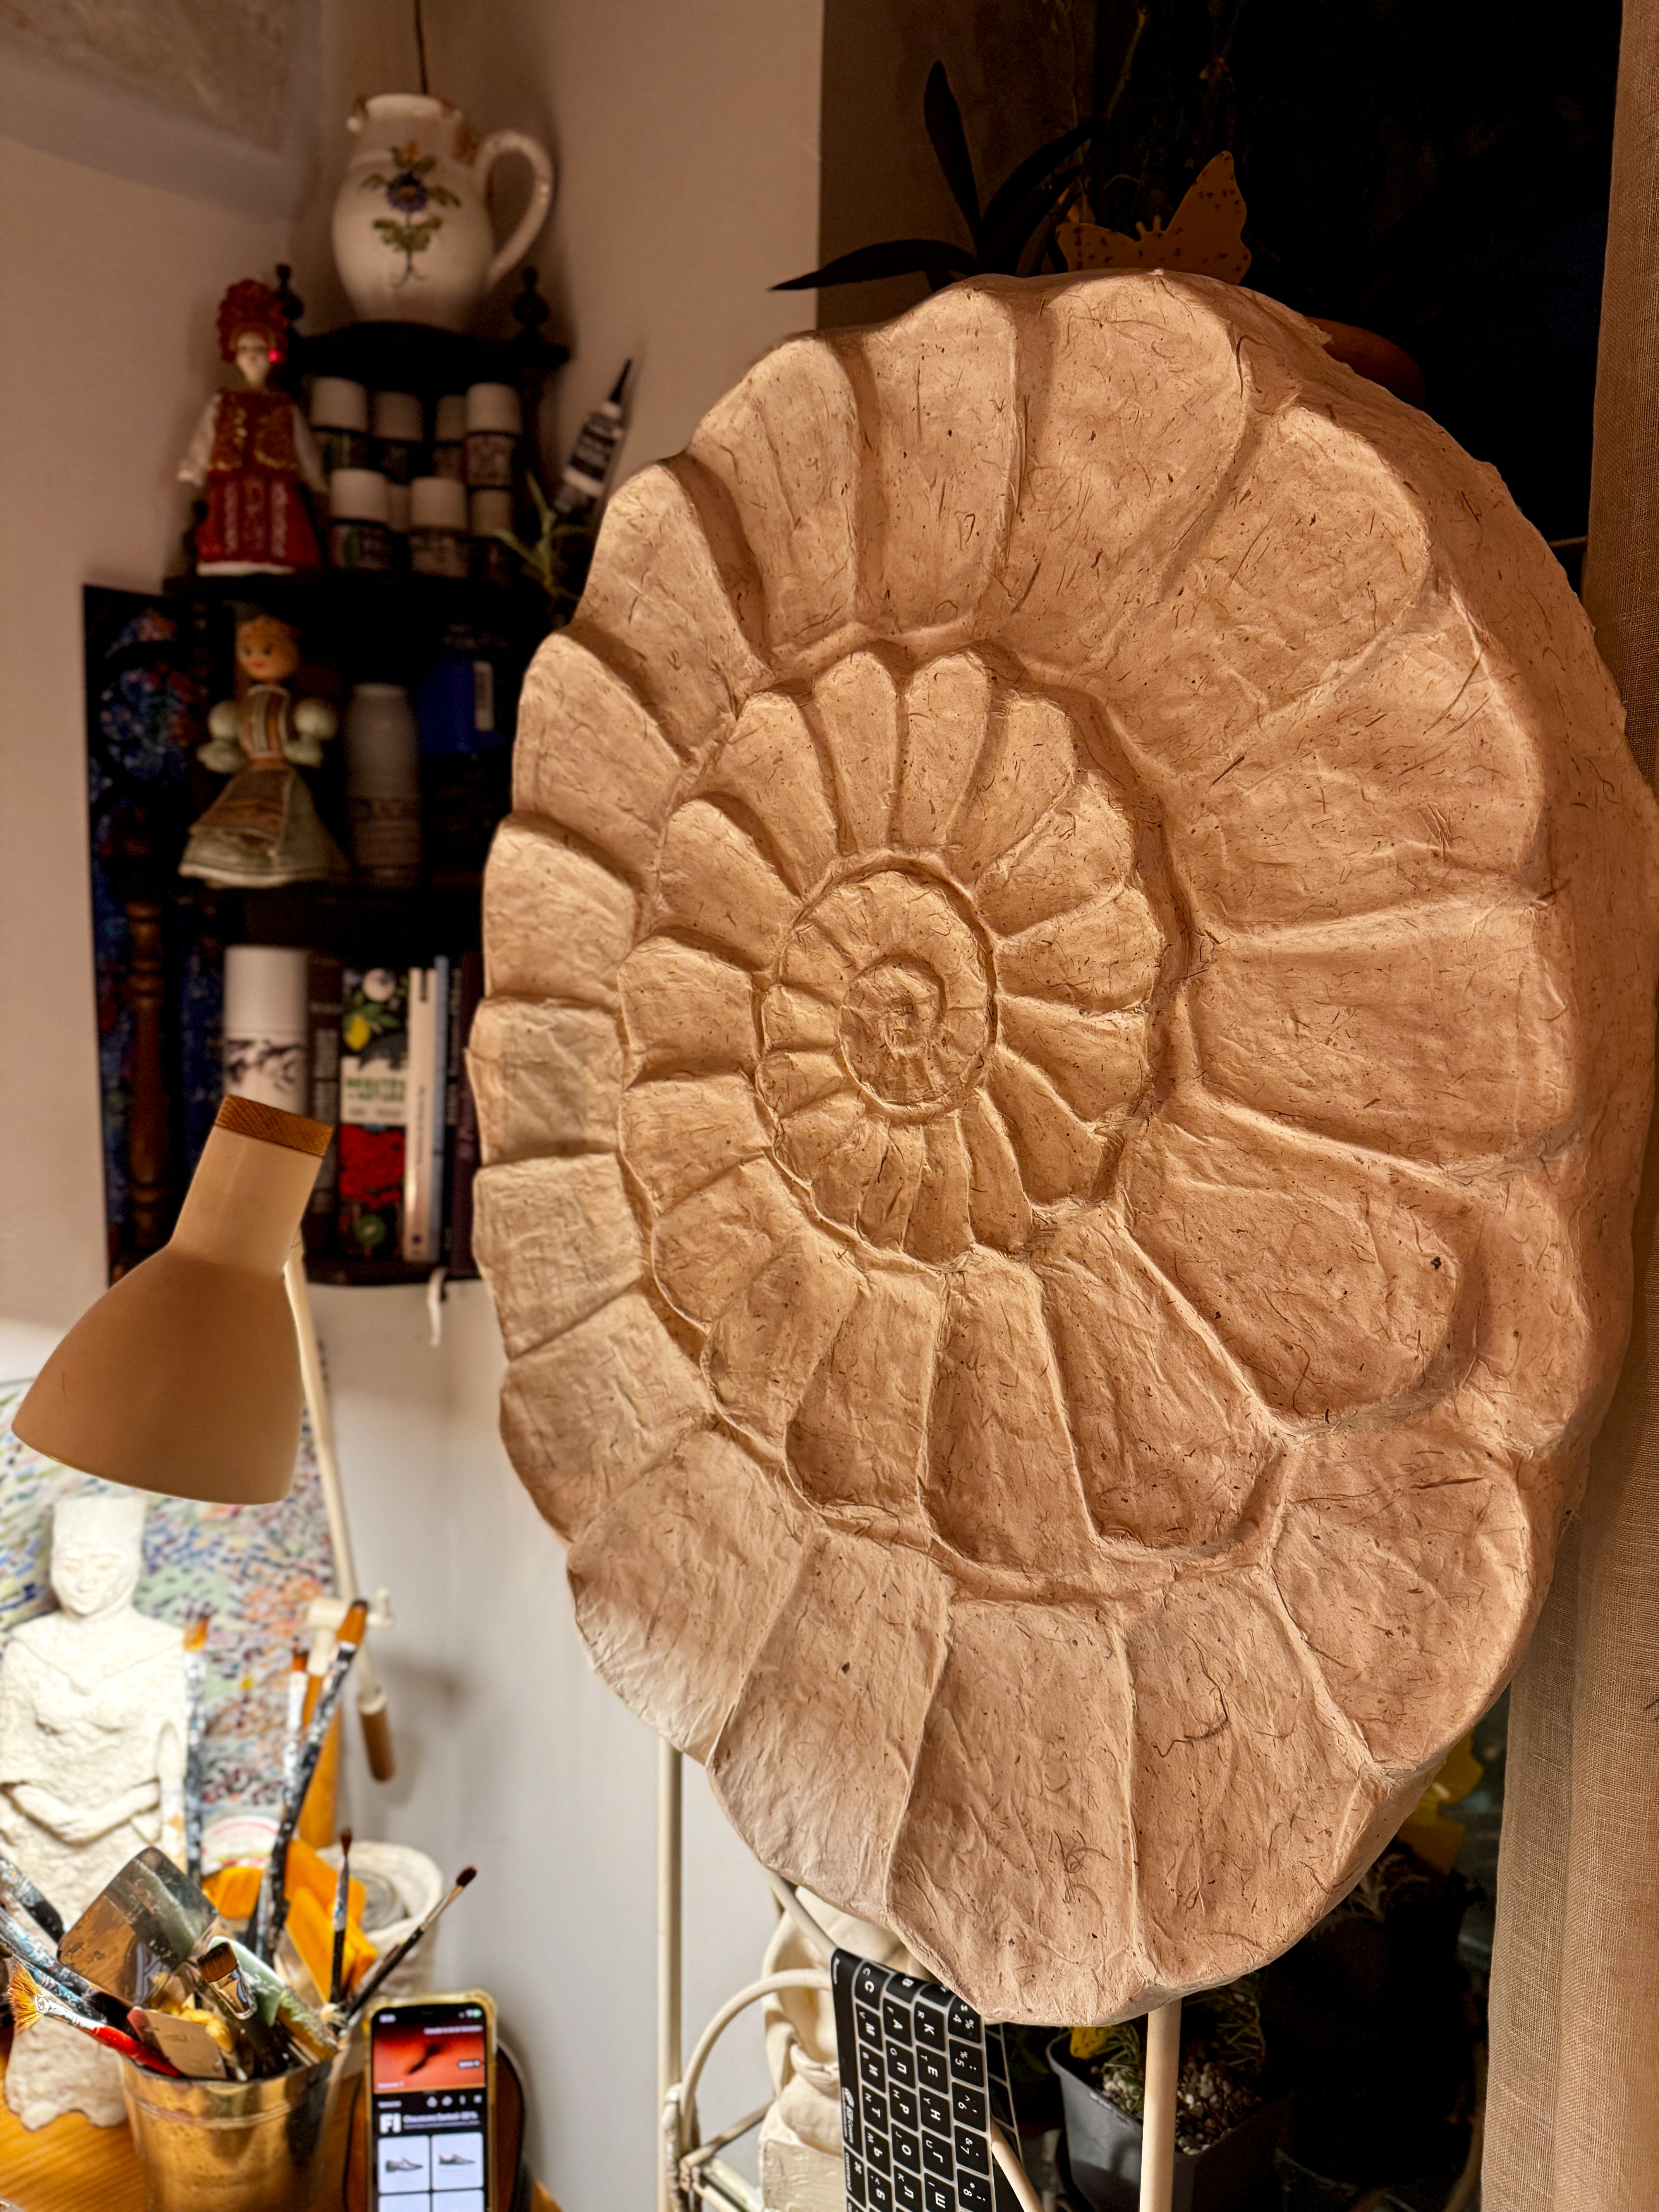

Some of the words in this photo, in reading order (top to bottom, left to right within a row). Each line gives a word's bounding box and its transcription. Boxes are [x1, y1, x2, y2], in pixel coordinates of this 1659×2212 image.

[917, 2011, 925, 2019] R
[953, 2014, 962, 2023] 4
[955, 2058, 964, 2067] 5
[869, 2064, 878, 2076] И
[897, 2062, 907, 2074] П
[865, 2093, 871, 2102] N
[893, 2089, 900, 2099] H
[867, 2133, 874, 2143] M
[926, 2140, 933, 2148] U
[960, 2145, 970, 2154] 7
[898, 2173, 905, 2182] K
